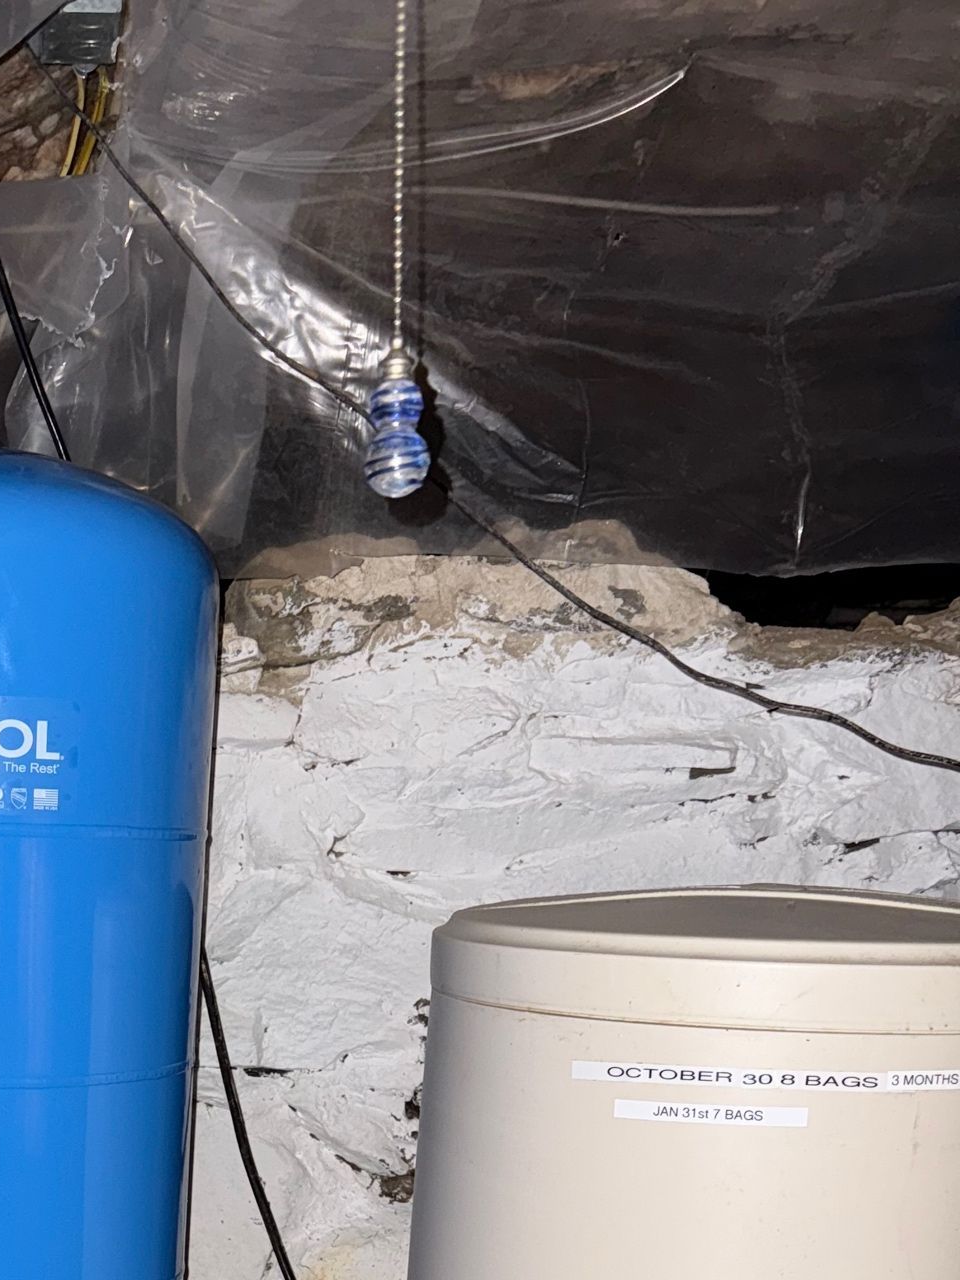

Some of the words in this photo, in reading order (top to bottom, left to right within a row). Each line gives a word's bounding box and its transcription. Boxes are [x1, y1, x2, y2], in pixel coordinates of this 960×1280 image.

[3, 761, 27, 773] The
[607, 1066, 733, 1083] OCTOBER
[742, 1073, 773, 1085] 30
[780, 1074, 796, 1086] 8
[805, 1075, 878, 1088] BAGS
[891, 1074, 900, 1086] 3
[903, 1073, 959, 1086] MONTHS
[653, 1106, 679, 1117] JAN
[682, 1107, 709, 1119] 31st
[713, 1109, 721, 1119] 7
[725, 1109, 764, 1121] BAGS
